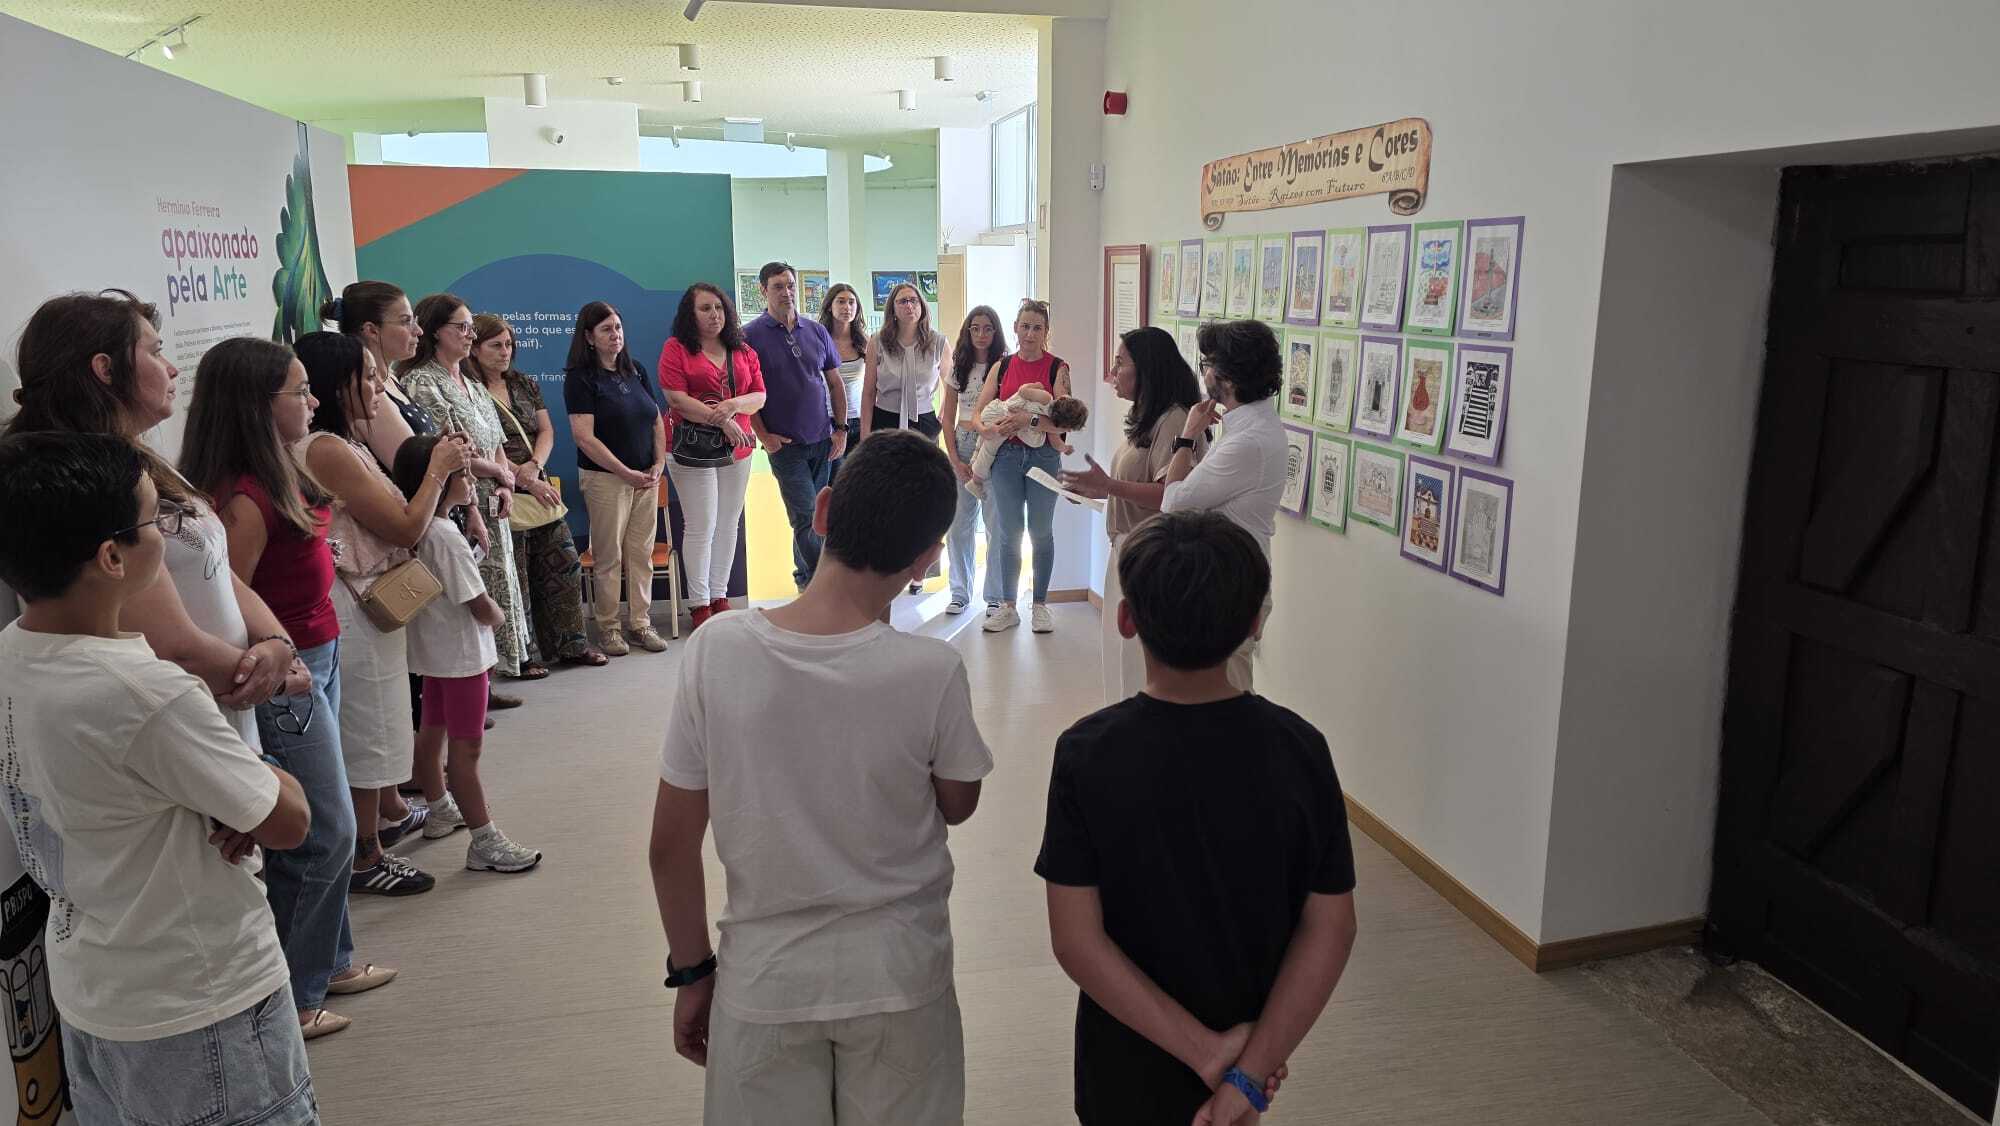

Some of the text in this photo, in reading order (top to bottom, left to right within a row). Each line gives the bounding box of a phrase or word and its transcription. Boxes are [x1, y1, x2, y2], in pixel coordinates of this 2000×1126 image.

[1243, 157, 1274, 192] Entre
[1277, 140, 1350, 185] Memórias
[1355, 143, 1364, 165] e
[1368, 127, 1420, 172] Cores
[192, 200, 222, 218] Ferreira
[161, 223, 259, 272] apaixonado
[166, 264, 248, 317] pela Arte
[502, 311, 532, 321] pelas
[534, 311, 572, 321] formas
[525, 324, 539, 335] do
[541, 326, 562, 337] que
